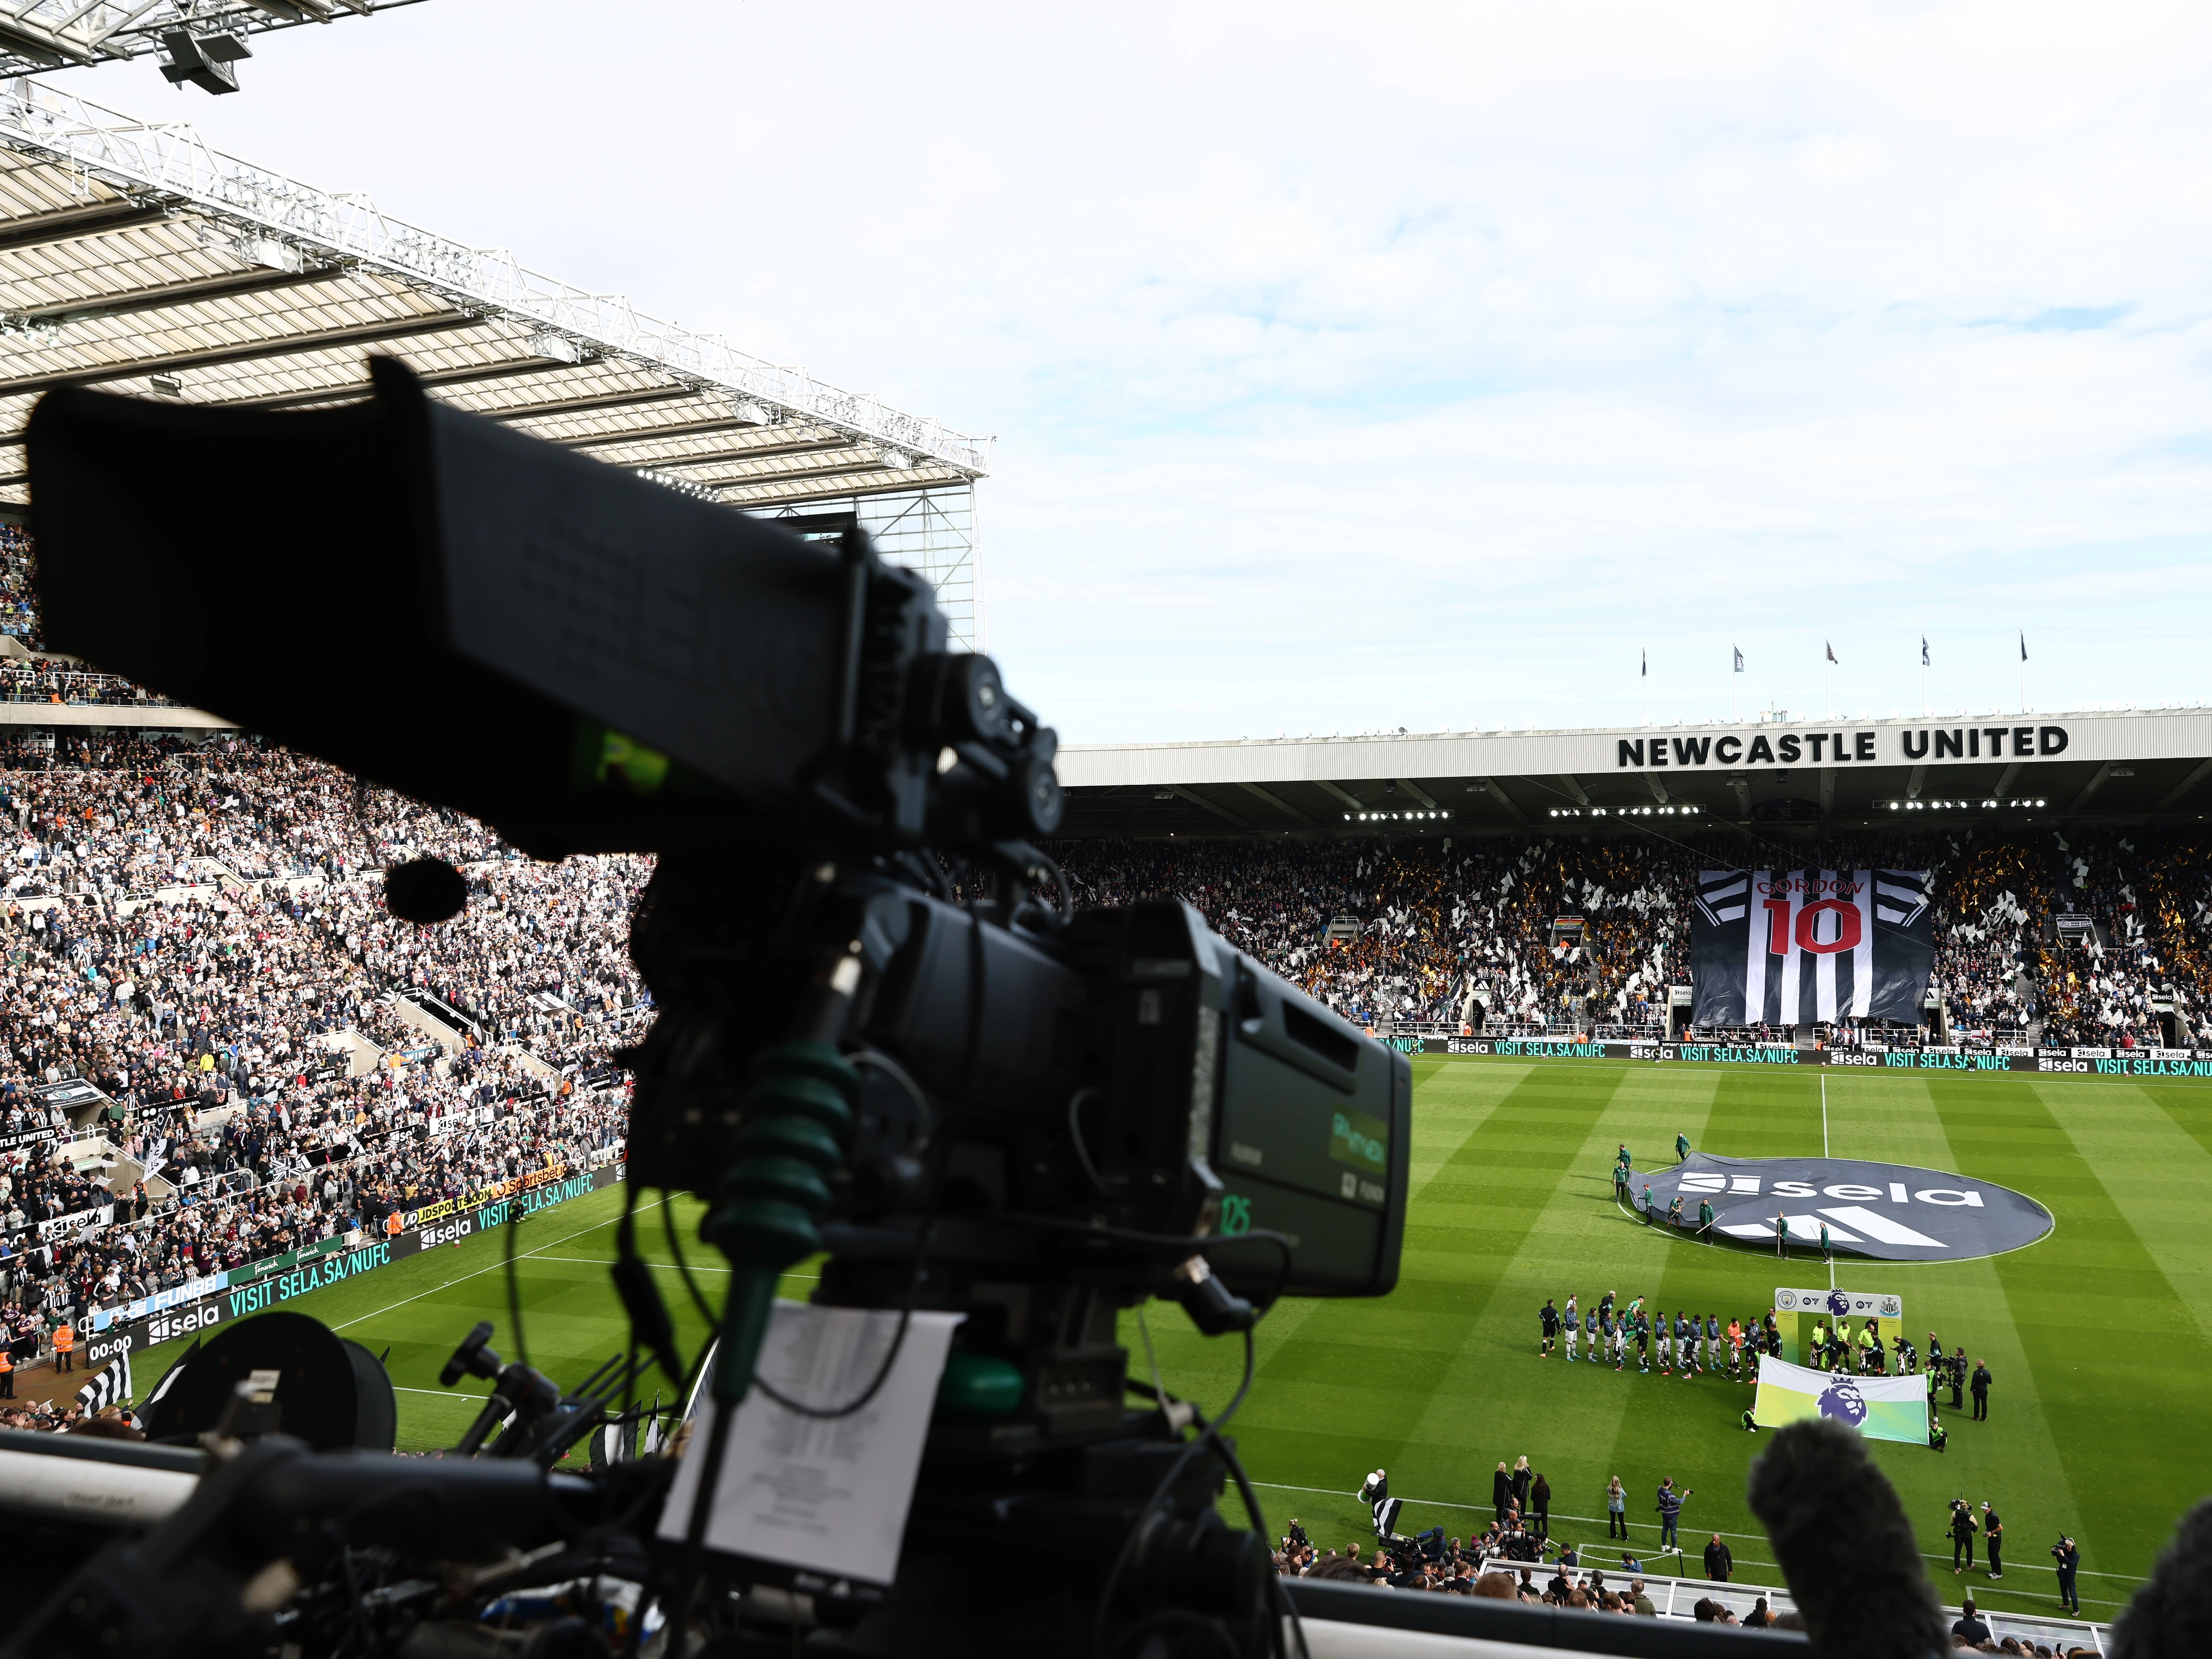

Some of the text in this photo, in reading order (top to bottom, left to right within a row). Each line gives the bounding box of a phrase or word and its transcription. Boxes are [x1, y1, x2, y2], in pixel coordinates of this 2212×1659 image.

[1618, 726, 2069, 767] NEWCASTLE UNITED
[1756, 878, 1865, 895] GORDON
[1763, 898, 1861, 955] 10
[406, 1048, 436, 1061] WINGS
[1460, 1042, 1488, 1053] sela
[1494, 1042, 1605, 1057] VISIT SELA.SA/NUFC
[1681, 1047, 1798, 1064] VISIT SELA.SA/NUFC
[2046, 1048, 2066, 1057] sela
[1845, 1052, 1877, 1065] sela
[1885, 1053, 1915, 1067] VISIT
[2054, 1059, 2088, 1072] sela
[2095, 1059, 2129, 1074] VISIT
[0, 1129, 55, 1147] TLE UNITED
[400, 1127, 414, 1141] sel
[478, 1173, 593, 1230] VISIT ELA.SA/NUFC
[1769, 1181, 1984, 1207] sela
[405, 1189, 492, 1226] JD JDSPOTSCOM
[436, 1219, 471, 1244] sela
[297, 1246, 319, 1262] Fenwick
[255, 1260, 278, 1275] Fenwick
[229, 1242, 390, 1317] VISIT SELA.SA/NUFC
[155, 1275, 217, 1310] FUN88
[172, 1305, 219, 1336] sela
[90, 1335, 132, 1361] 00:00
